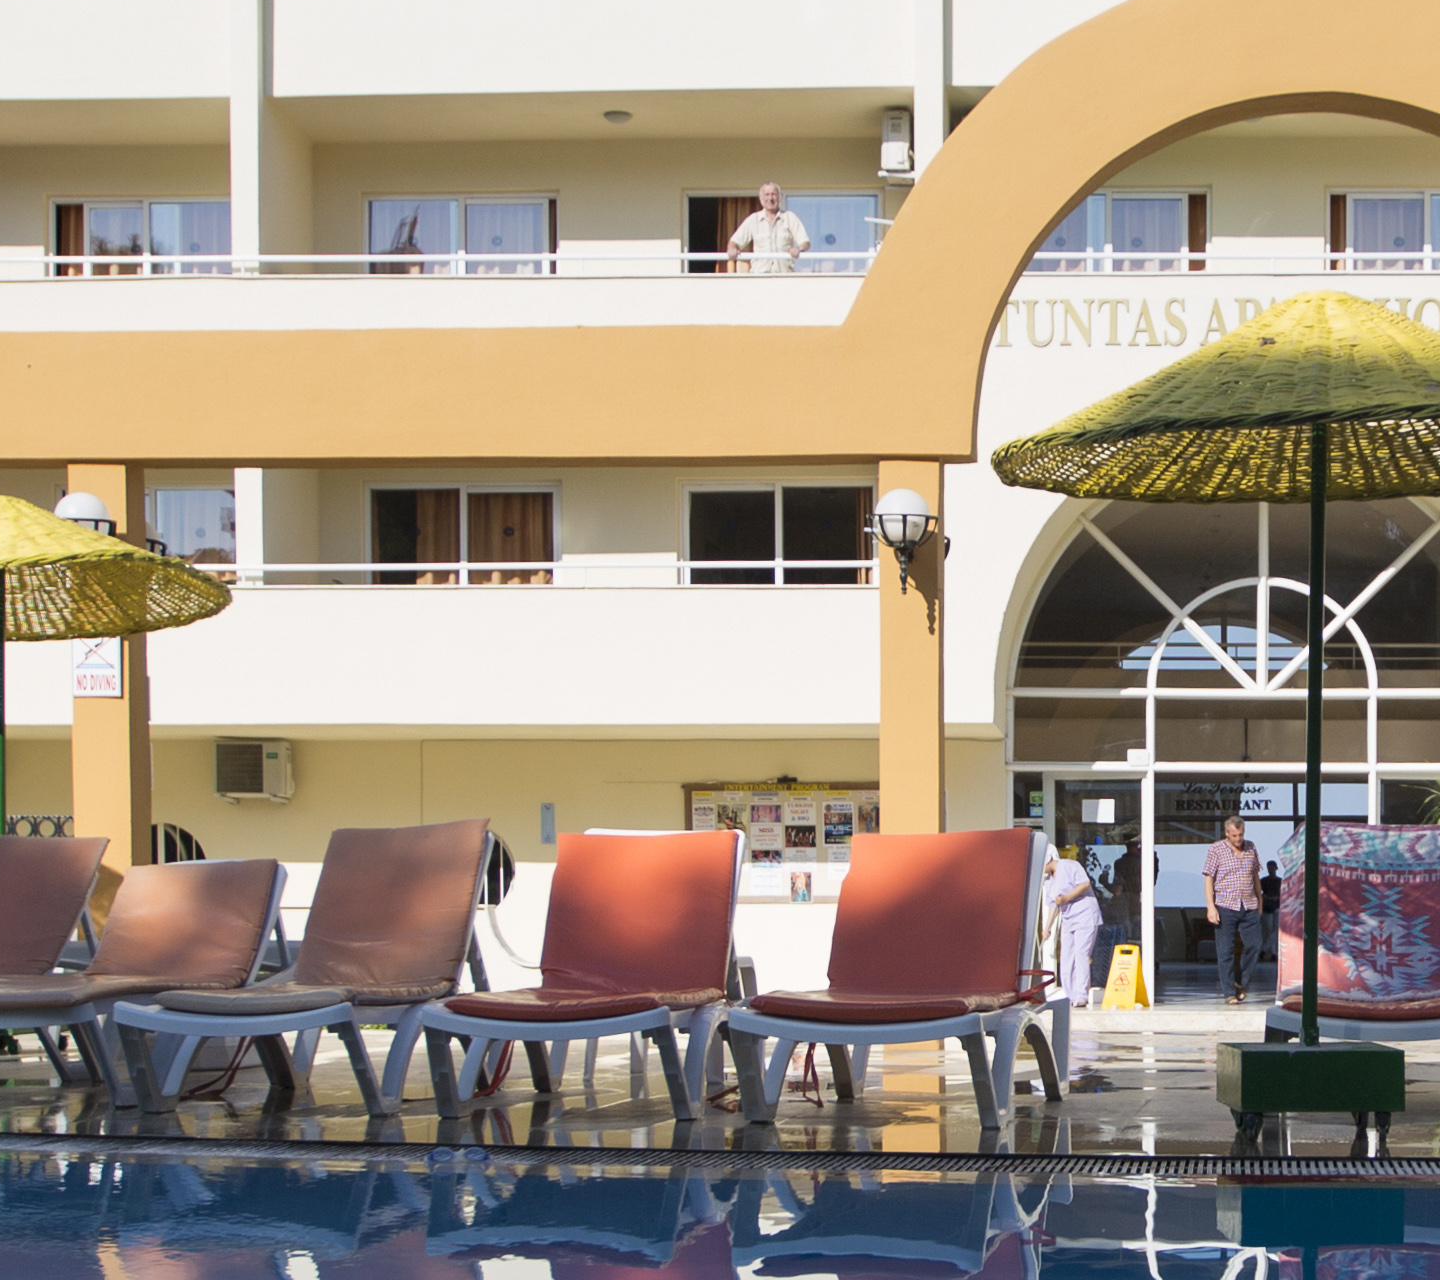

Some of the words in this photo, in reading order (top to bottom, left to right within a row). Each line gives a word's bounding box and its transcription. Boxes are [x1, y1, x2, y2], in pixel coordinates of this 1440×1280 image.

[995, 297, 1188, 347] TUNTAS
[76, 674, 87, 690] NO
[90, 674, 116, 690] DIVING
[1175, 799, 1271, 811] RESTAURANT
